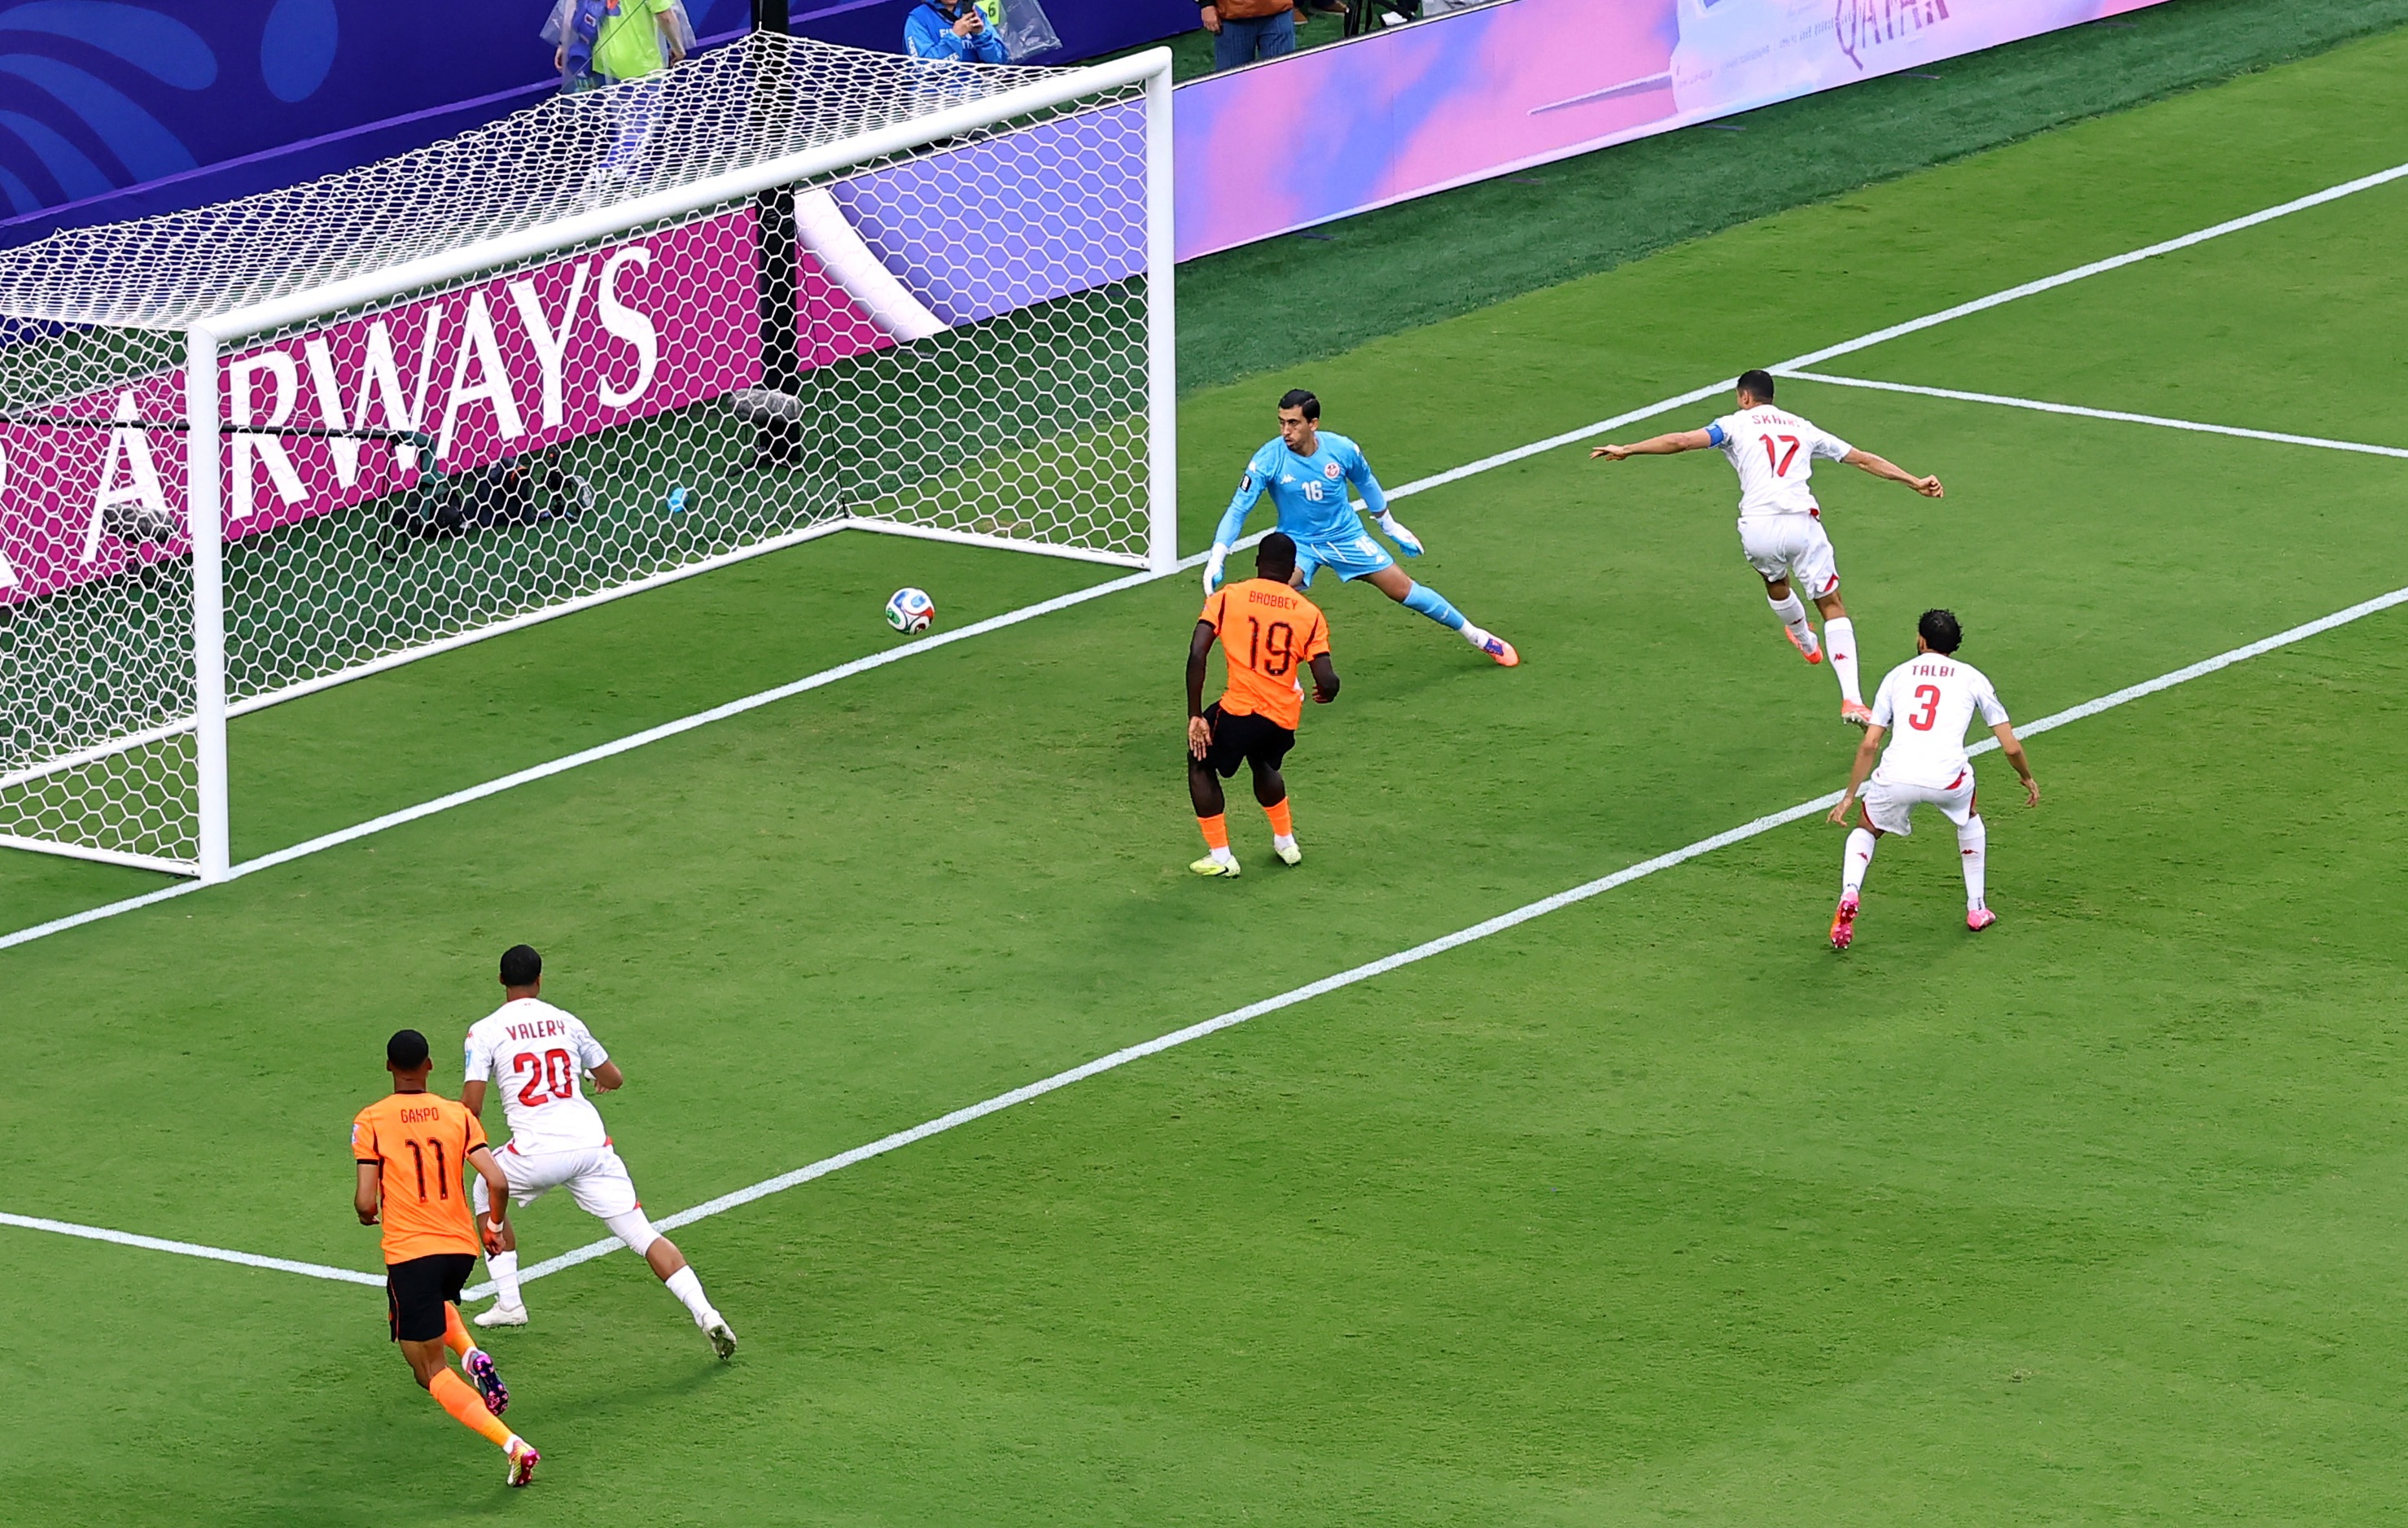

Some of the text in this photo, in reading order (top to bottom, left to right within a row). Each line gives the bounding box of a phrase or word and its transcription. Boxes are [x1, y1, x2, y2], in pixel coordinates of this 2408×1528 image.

[1758, 433, 1801, 478] 17
[1302, 479, 1324, 501] 16
[1355, 534, 1378, 557] 16
[1249, 590, 1298, 611] BROBBEY
[1248, 615, 1294, 676] 19
[1912, 664, 1955, 677] TALBI
[1908, 684, 1942, 731] 3
[505, 1019, 566, 1041] VALERY
[514, 1048, 573, 1107] 20
[401, 1107, 440, 1123] GAKPO
[405, 1136, 449, 1203] 11
